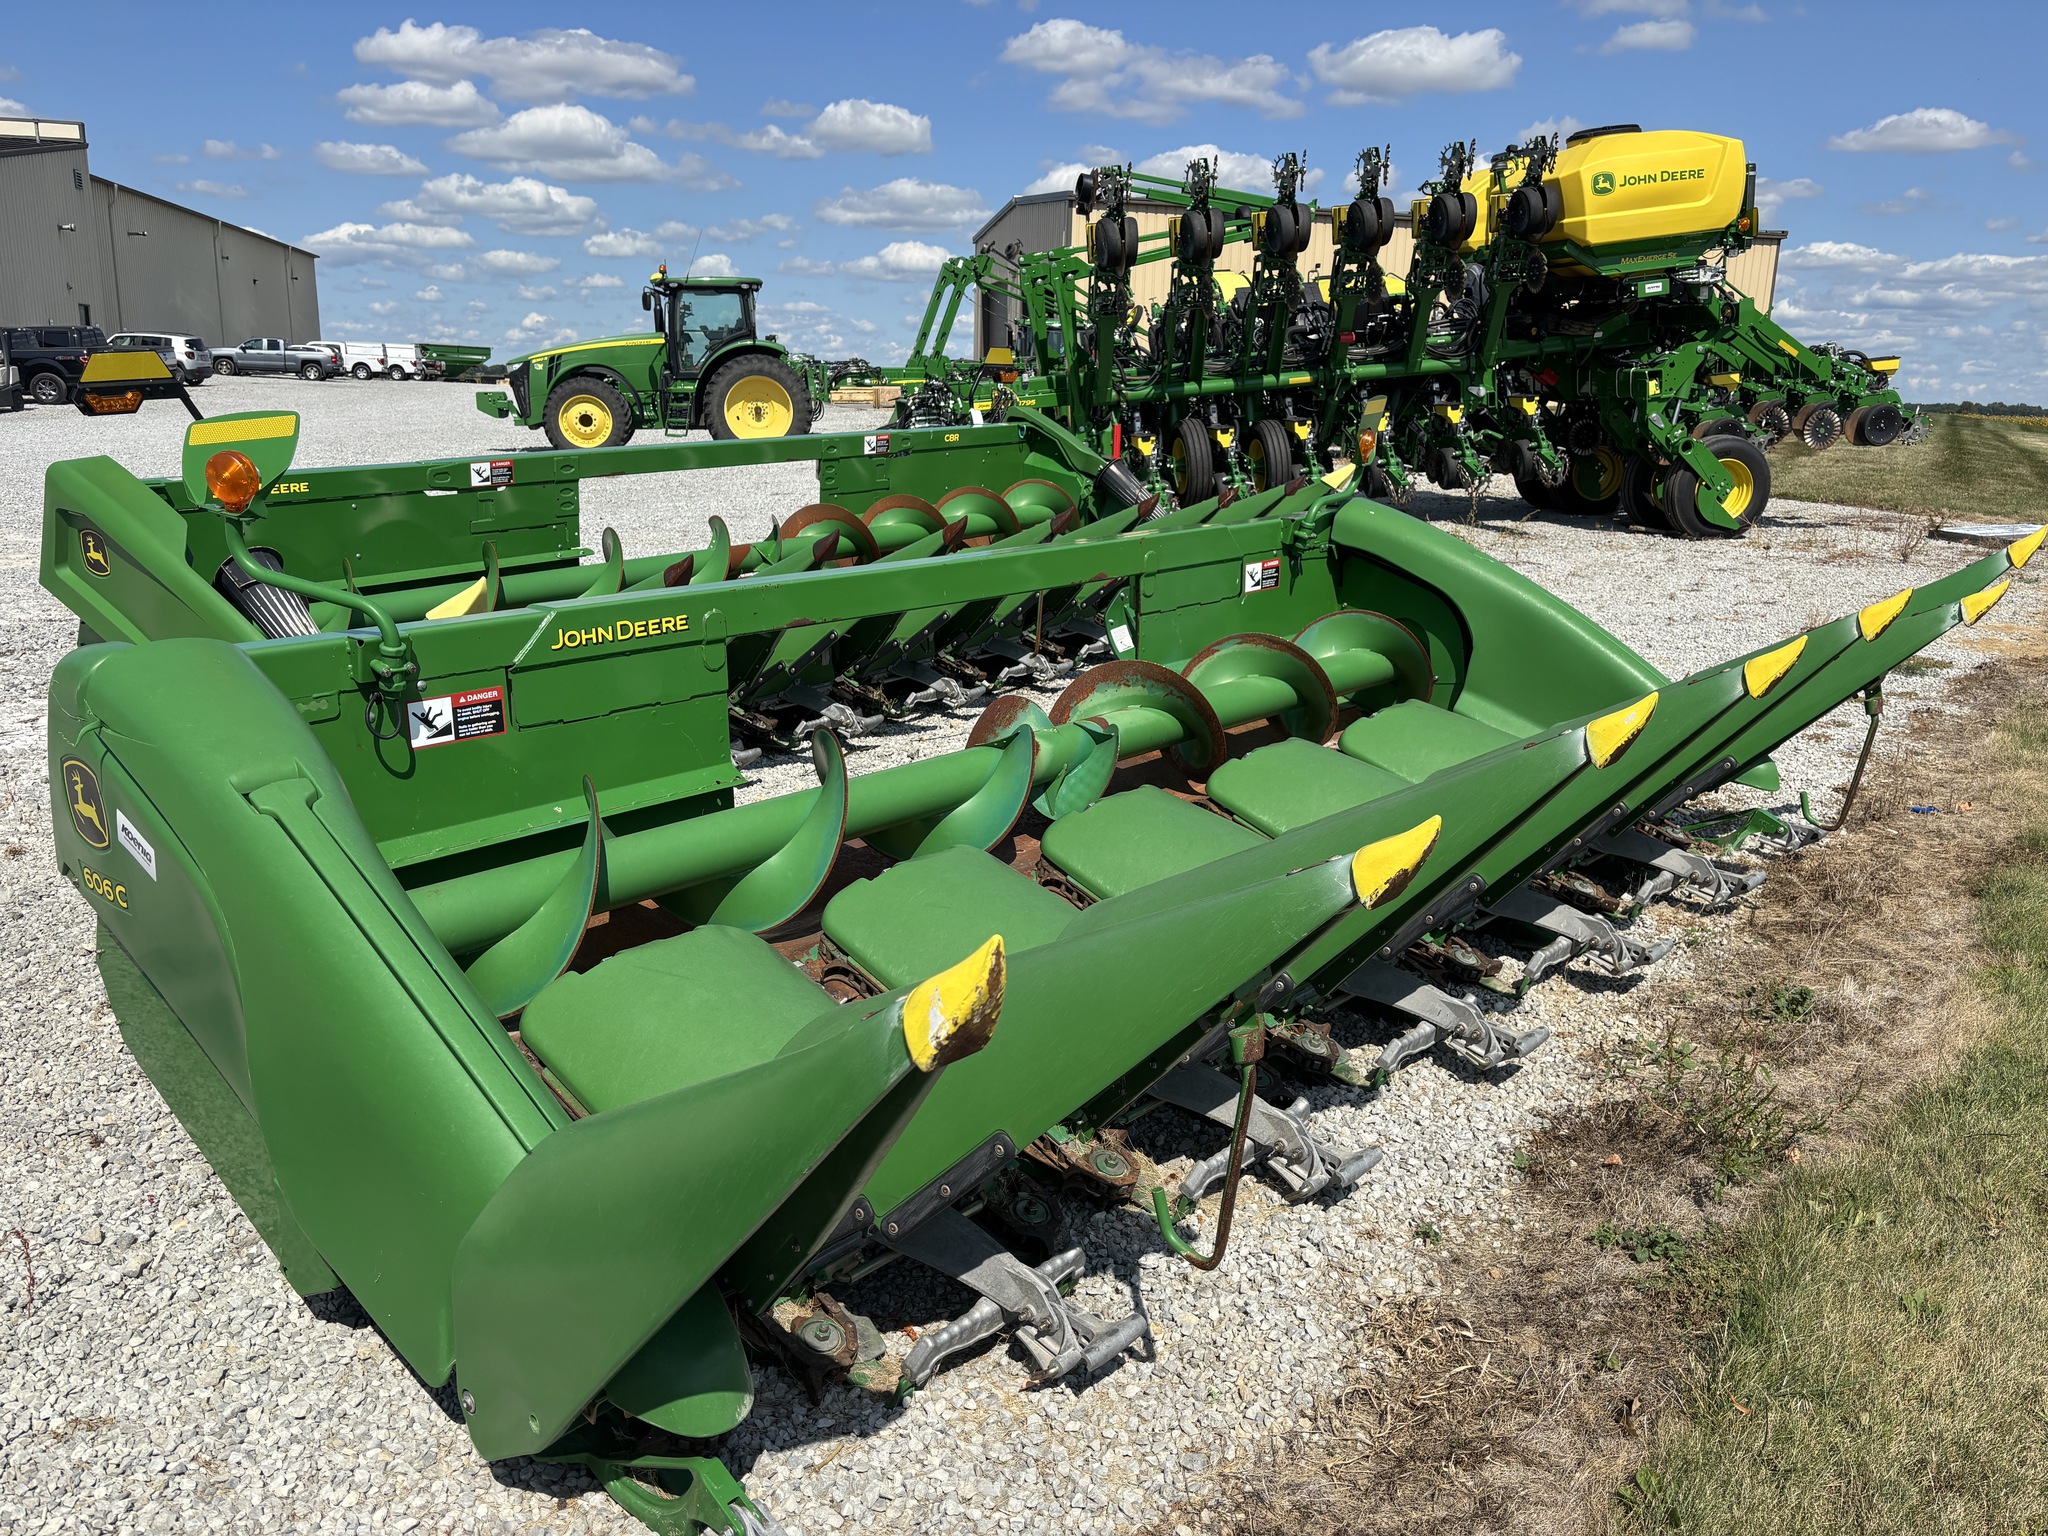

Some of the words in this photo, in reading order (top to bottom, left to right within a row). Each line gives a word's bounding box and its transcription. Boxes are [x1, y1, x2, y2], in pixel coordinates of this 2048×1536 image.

[1619, 173, 1657, 187] JOHN
[1660, 168, 1705, 182] DEERE
[551, 625, 613, 651] JOHN
[616, 614, 689, 641] DEERE
[467, 691, 498, 701] DANGER
